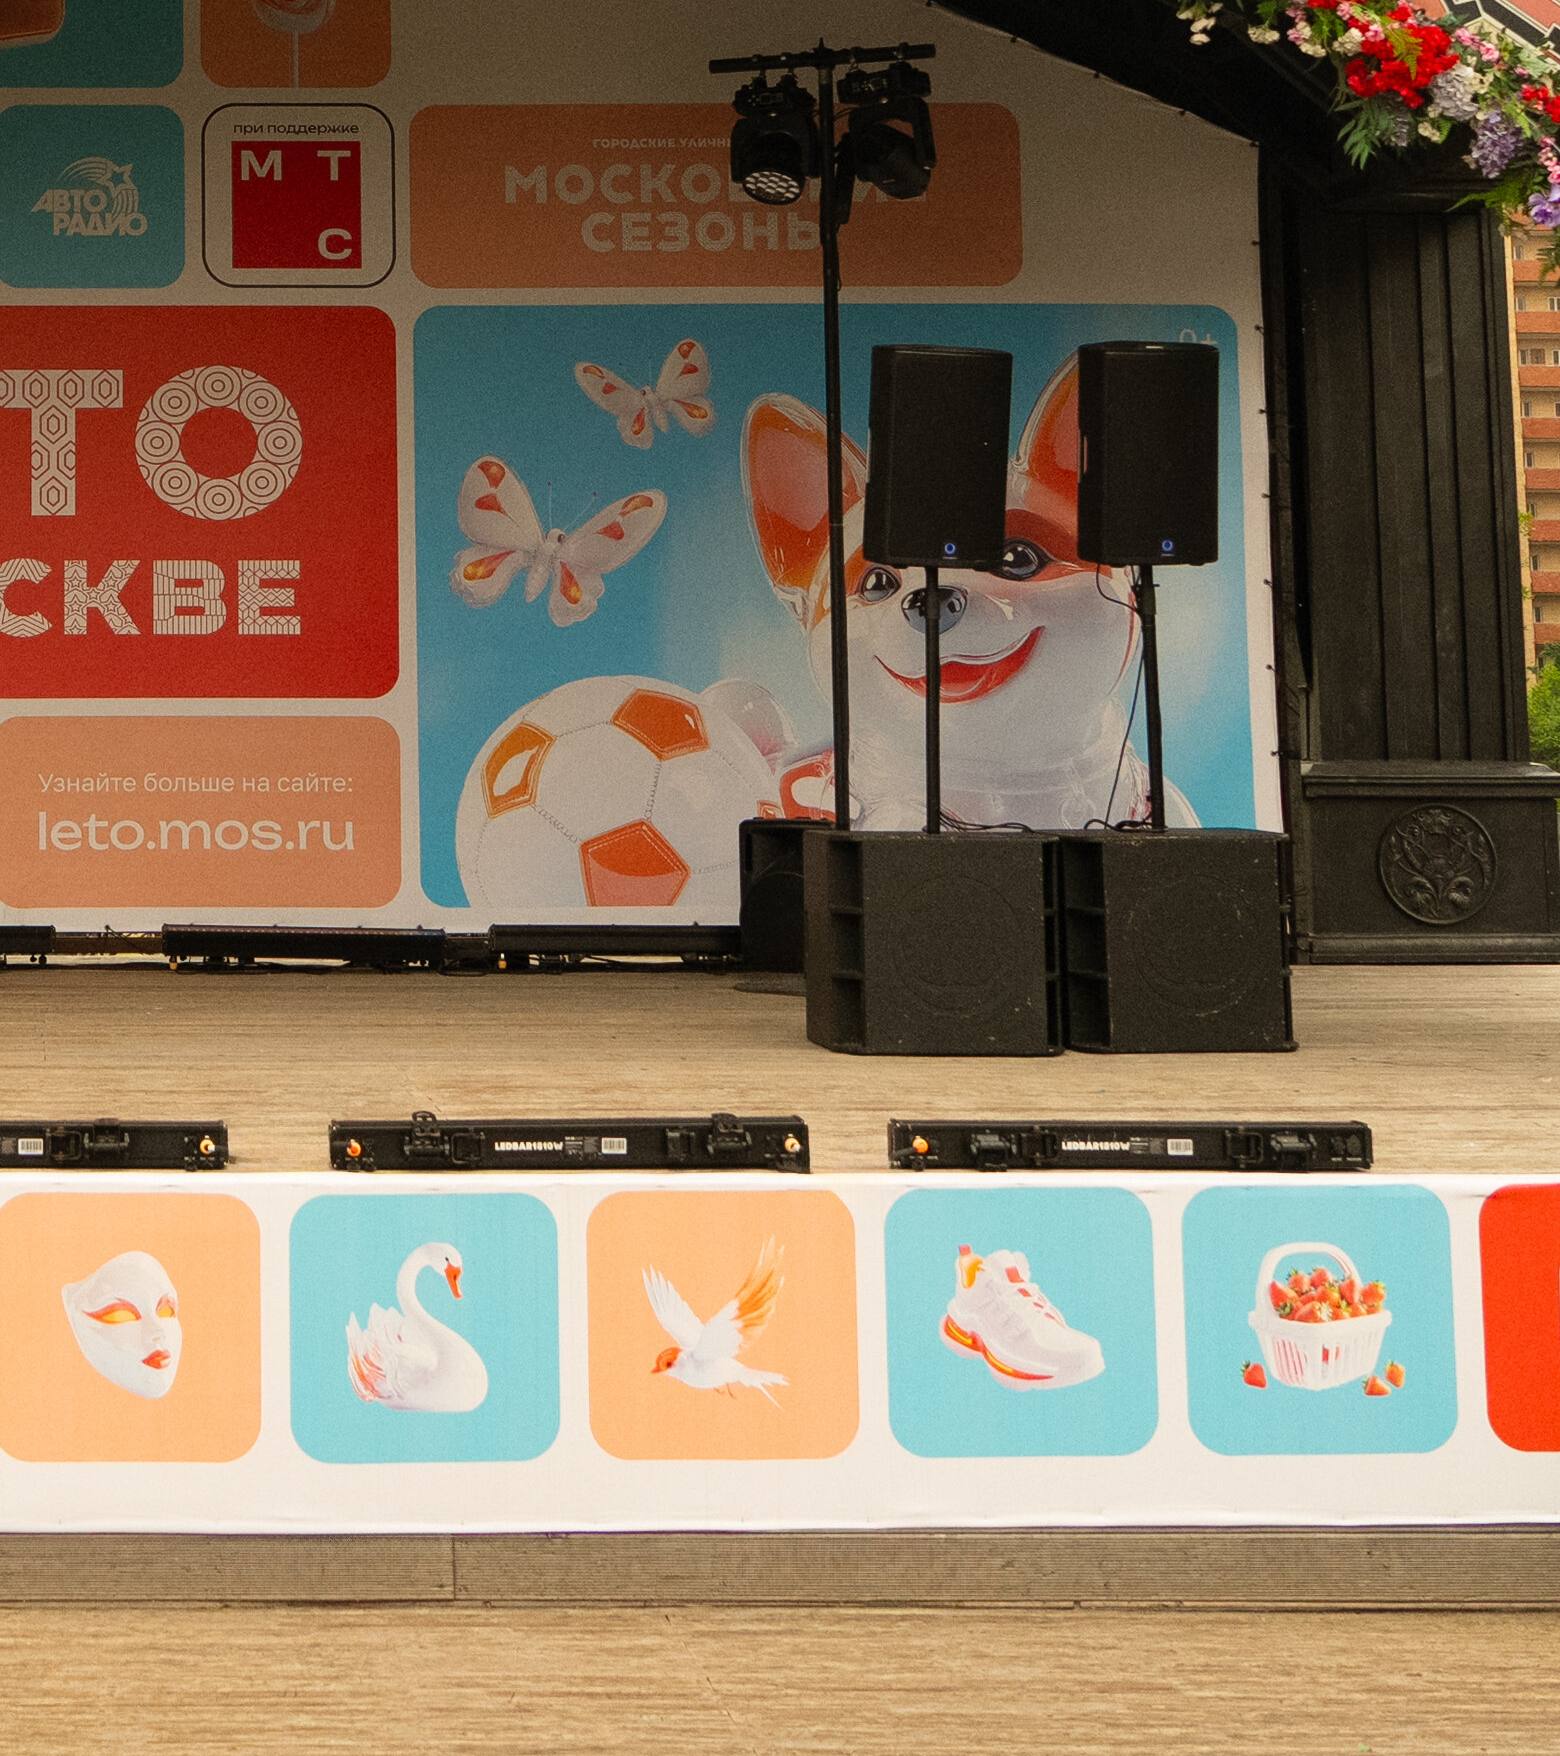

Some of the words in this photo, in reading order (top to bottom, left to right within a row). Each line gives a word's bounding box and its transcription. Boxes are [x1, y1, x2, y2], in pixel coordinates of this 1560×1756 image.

[233, 124, 264, 135] при
[267, 124, 360, 135] поддержке
[591, 138, 676, 150] ГОРОДСКИЕ
[679, 137, 733, 149] УЛИЧН
[504, 162, 927, 205] МОСКО
[30, 189, 108, 213] АВТО
[53, 212, 149, 236] РАДИО
[38, 772, 137, 793] Узнайте
[143, 772, 235, 793] больше
[242, 776, 270, 793] на
[277, 772, 354, 793] сайте:
[38, 811, 355, 851] leto.mos.ru
